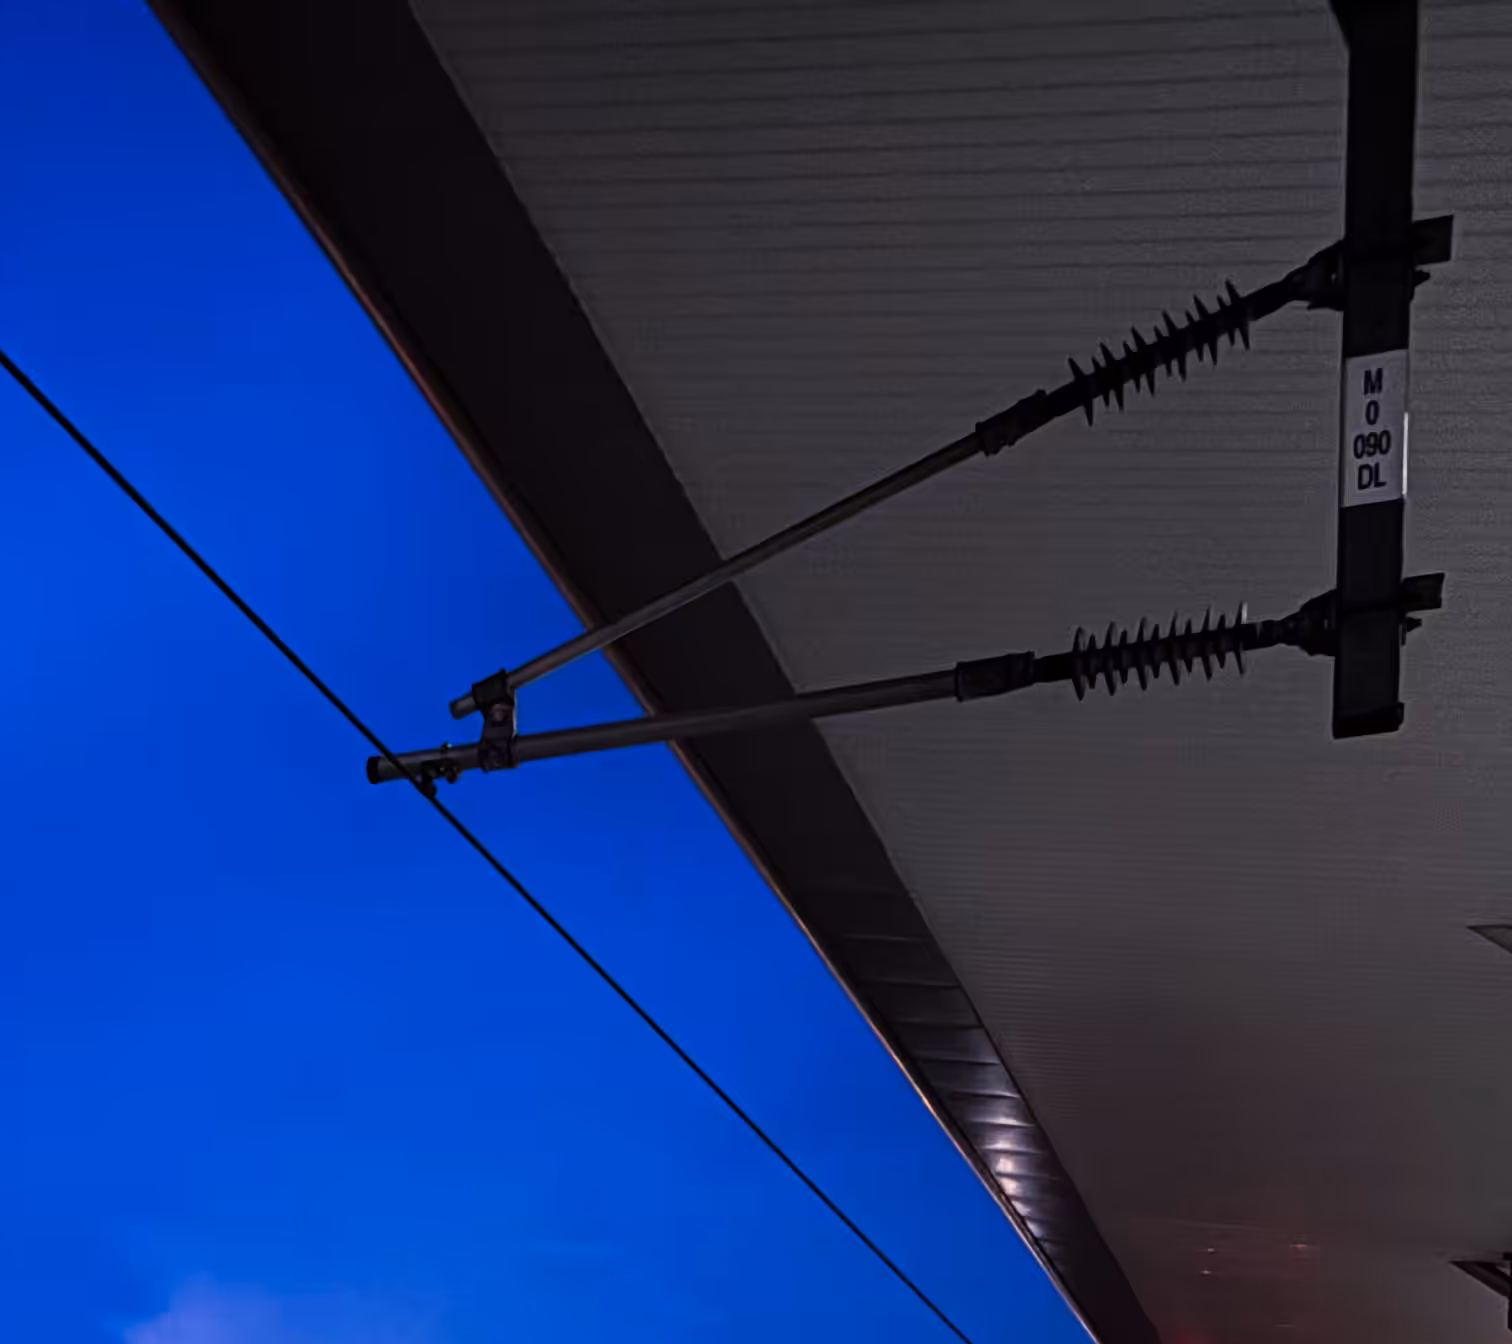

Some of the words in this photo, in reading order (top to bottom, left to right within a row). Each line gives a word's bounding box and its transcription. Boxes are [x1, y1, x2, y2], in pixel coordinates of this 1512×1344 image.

[1364, 368, 1383, 395] M
[1353, 430, 1392, 459] 090
[1357, 462, 1386, 491] DL
